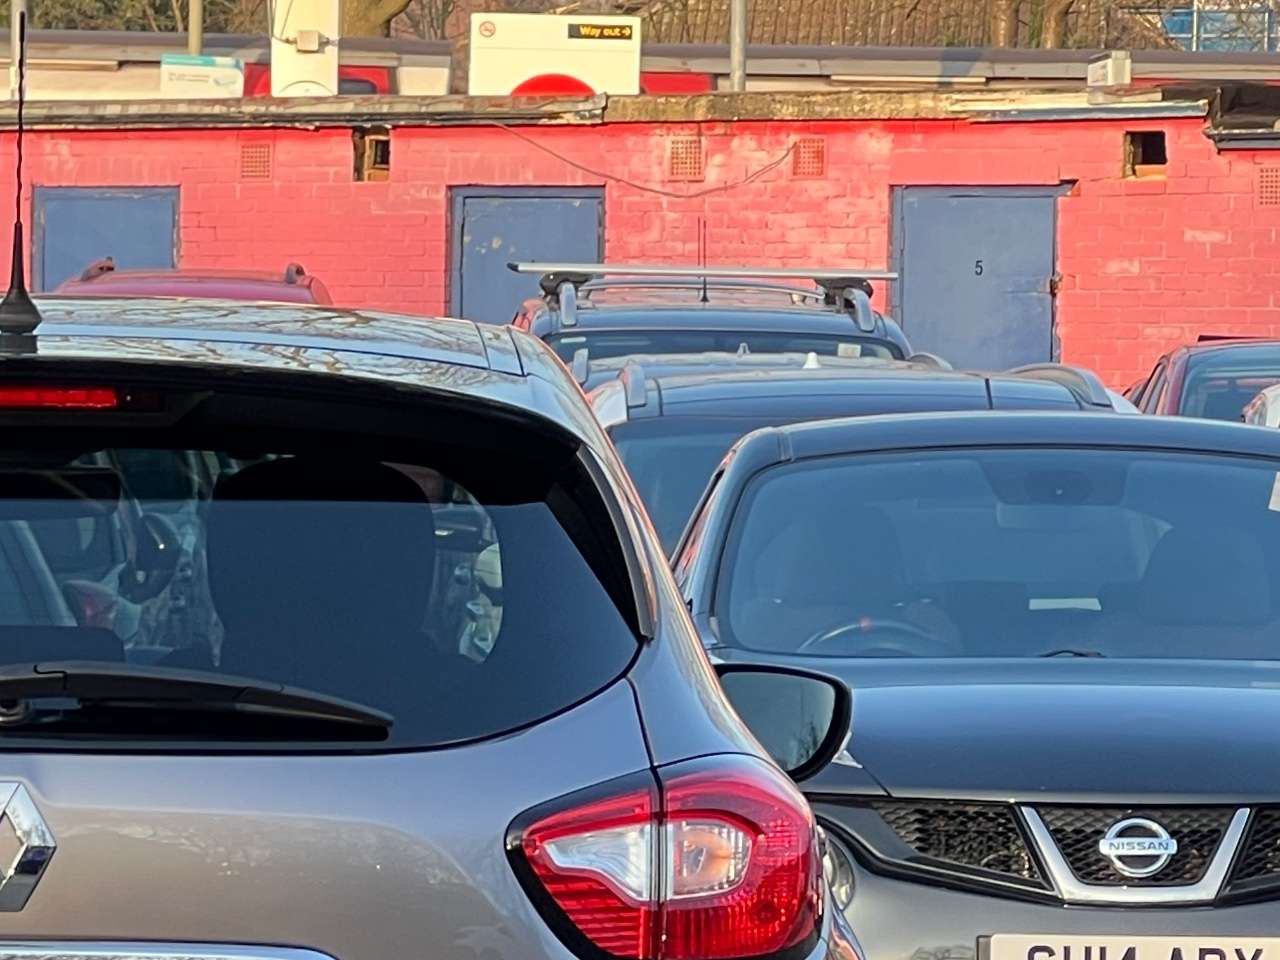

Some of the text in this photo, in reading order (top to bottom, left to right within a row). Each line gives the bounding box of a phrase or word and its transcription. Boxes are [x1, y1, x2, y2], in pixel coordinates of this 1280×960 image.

[579, 25, 621, 38] Way out
[975, 259, 984, 277] 5
[1108, 840, 1170, 852] NISSAN
